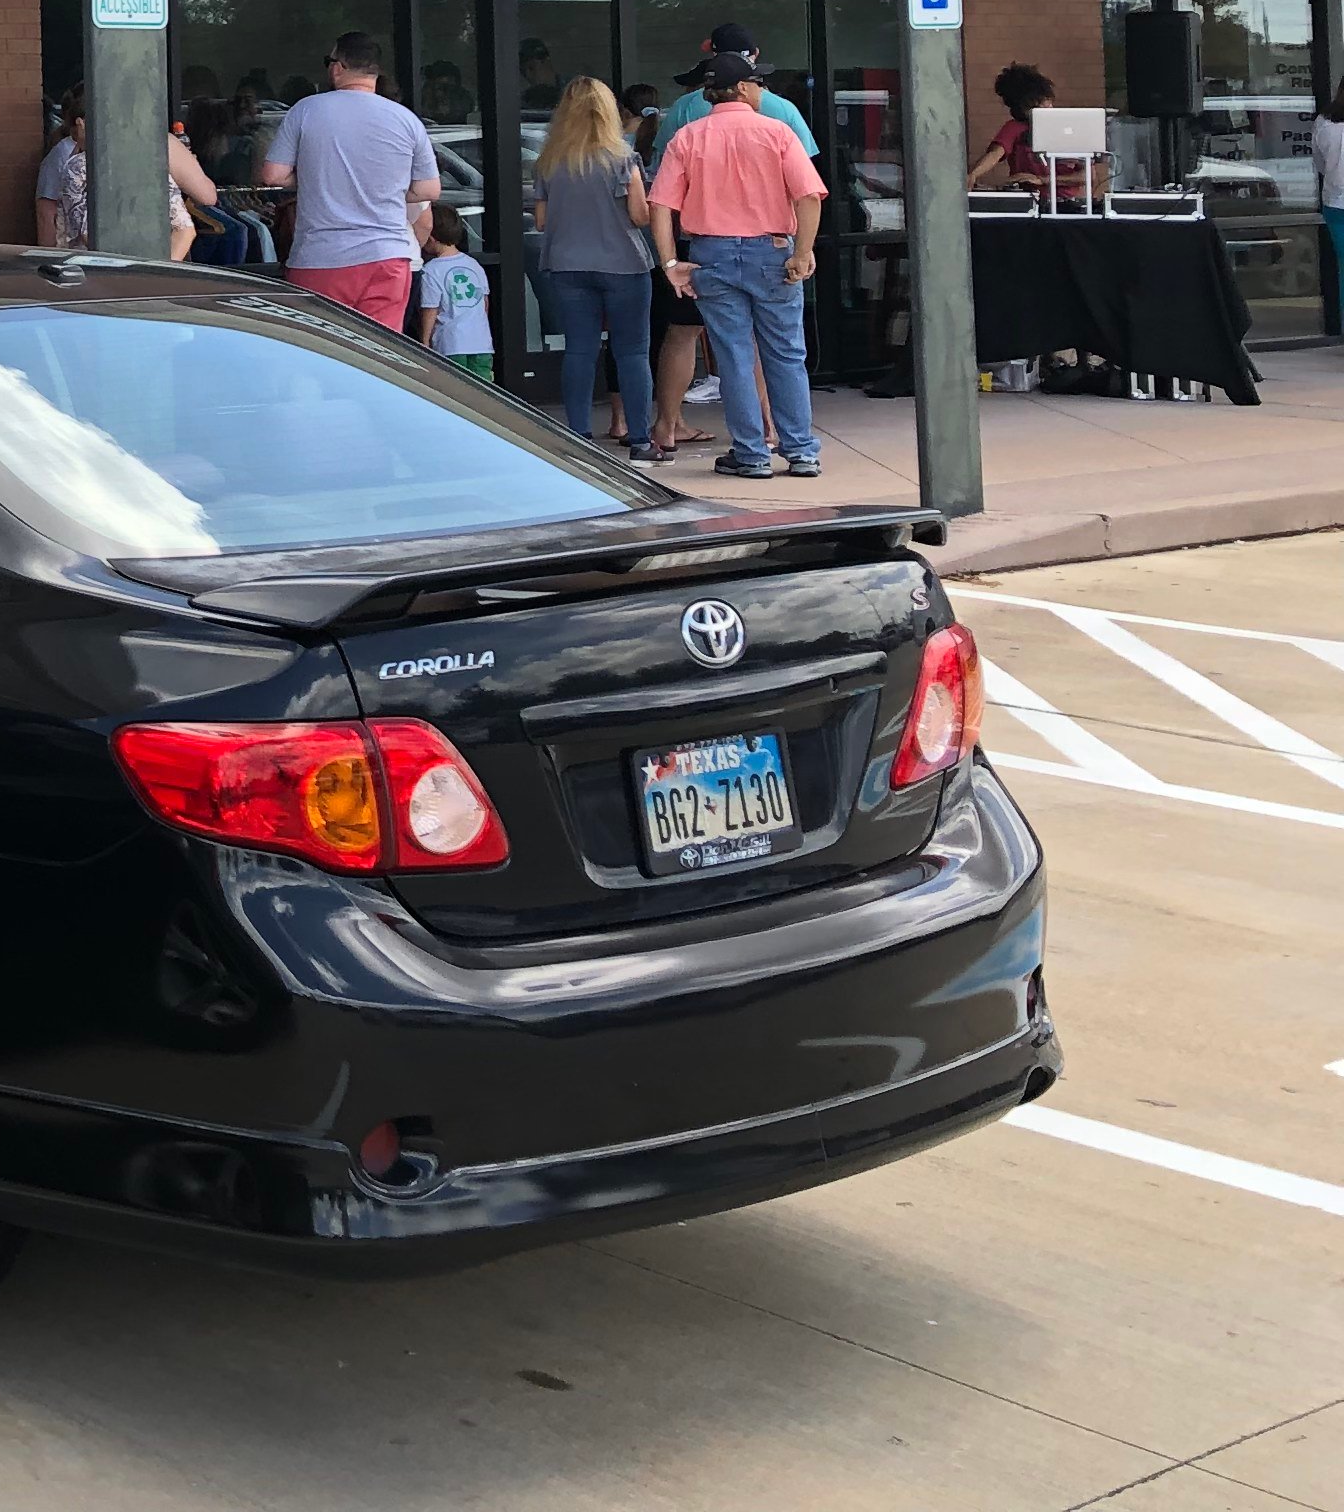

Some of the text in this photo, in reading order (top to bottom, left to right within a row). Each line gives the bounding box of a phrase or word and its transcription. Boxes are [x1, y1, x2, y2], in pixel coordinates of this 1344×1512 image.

[379, 650, 495, 680] COROLLA
[676, 744, 741, 777] TEXAS
[652, 785, 705, 844] BG2
